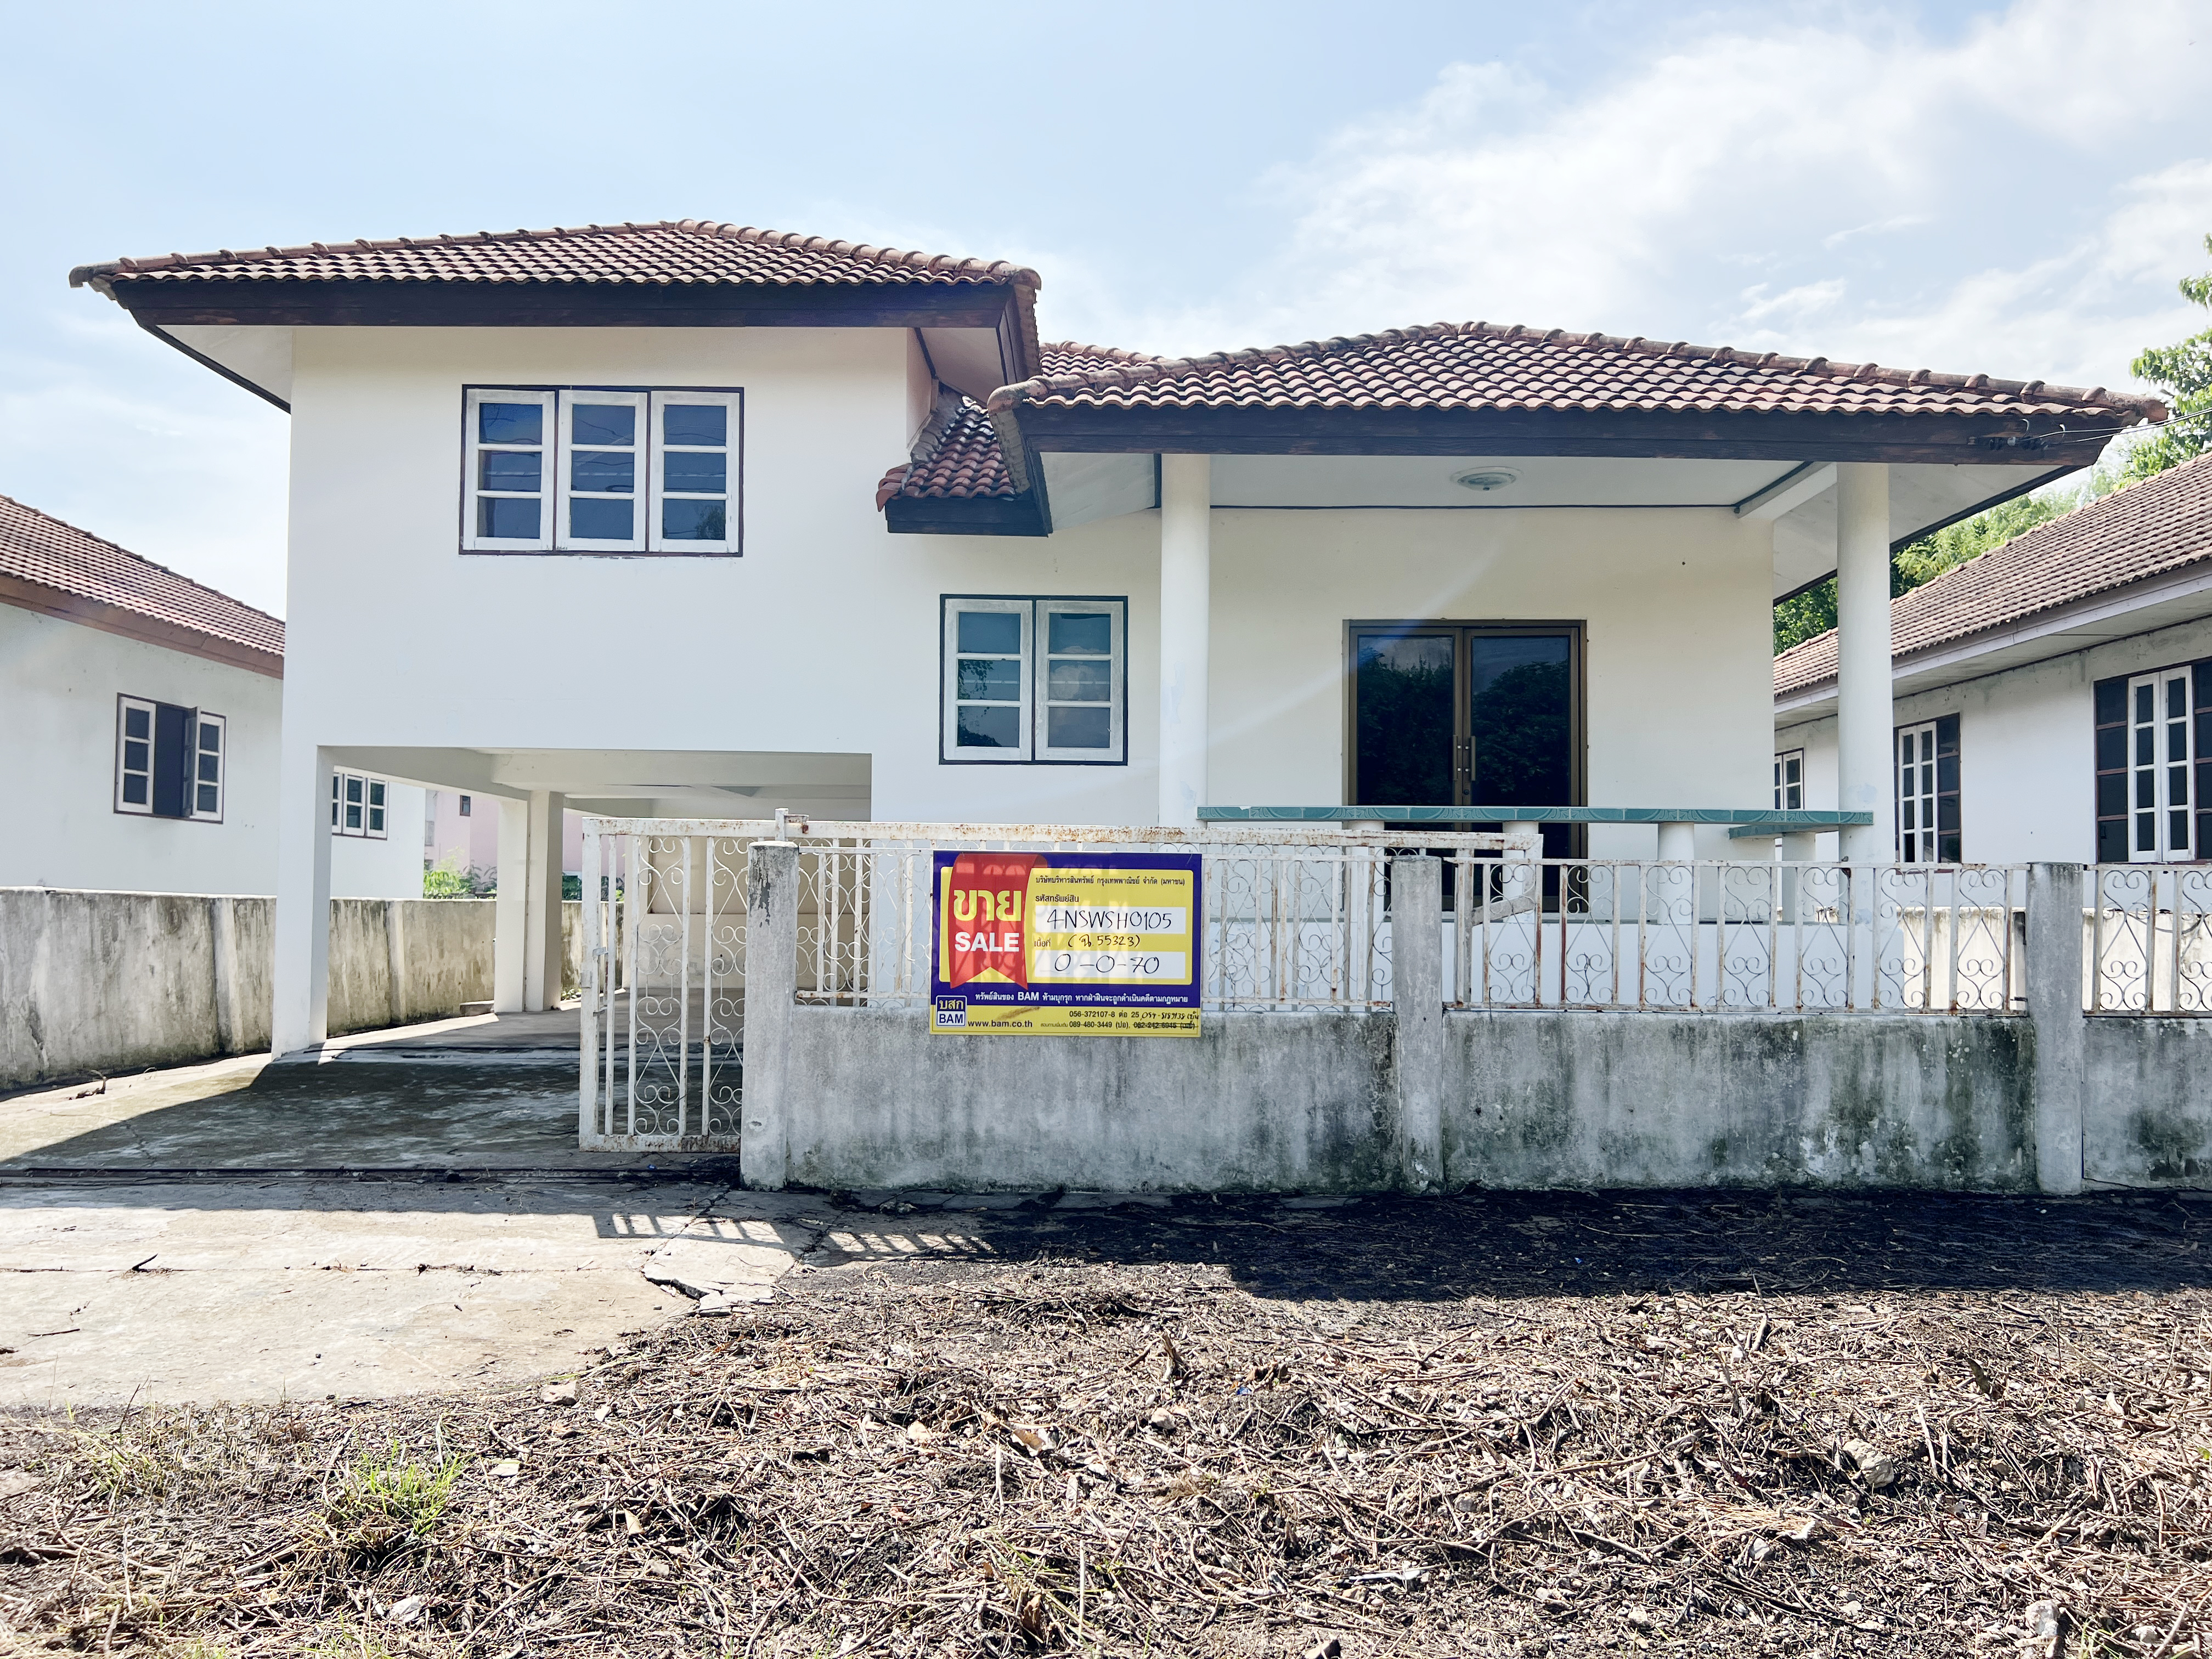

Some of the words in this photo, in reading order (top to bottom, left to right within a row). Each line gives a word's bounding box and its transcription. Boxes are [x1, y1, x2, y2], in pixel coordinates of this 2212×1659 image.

[1097, 876, 1140, 887] กรุงเทพพาณิชย์
[1142, 876, 1158, 884] จำกัด
[1035, 894, 1079, 902] รหัสทรัพย์สิน
[953, 889, 1022, 922] ขาย
[954, 932, 1019, 952] SALE
[1018, 991, 1039, 1001] BAM
[1042, 992, 1072, 1004] ห้ามบุกรุก
[939, 999, 964, 1010] บสก
[939, 1013, 963, 1024] BAM
[1119, 1009, 1128, 1018] ต่อ
